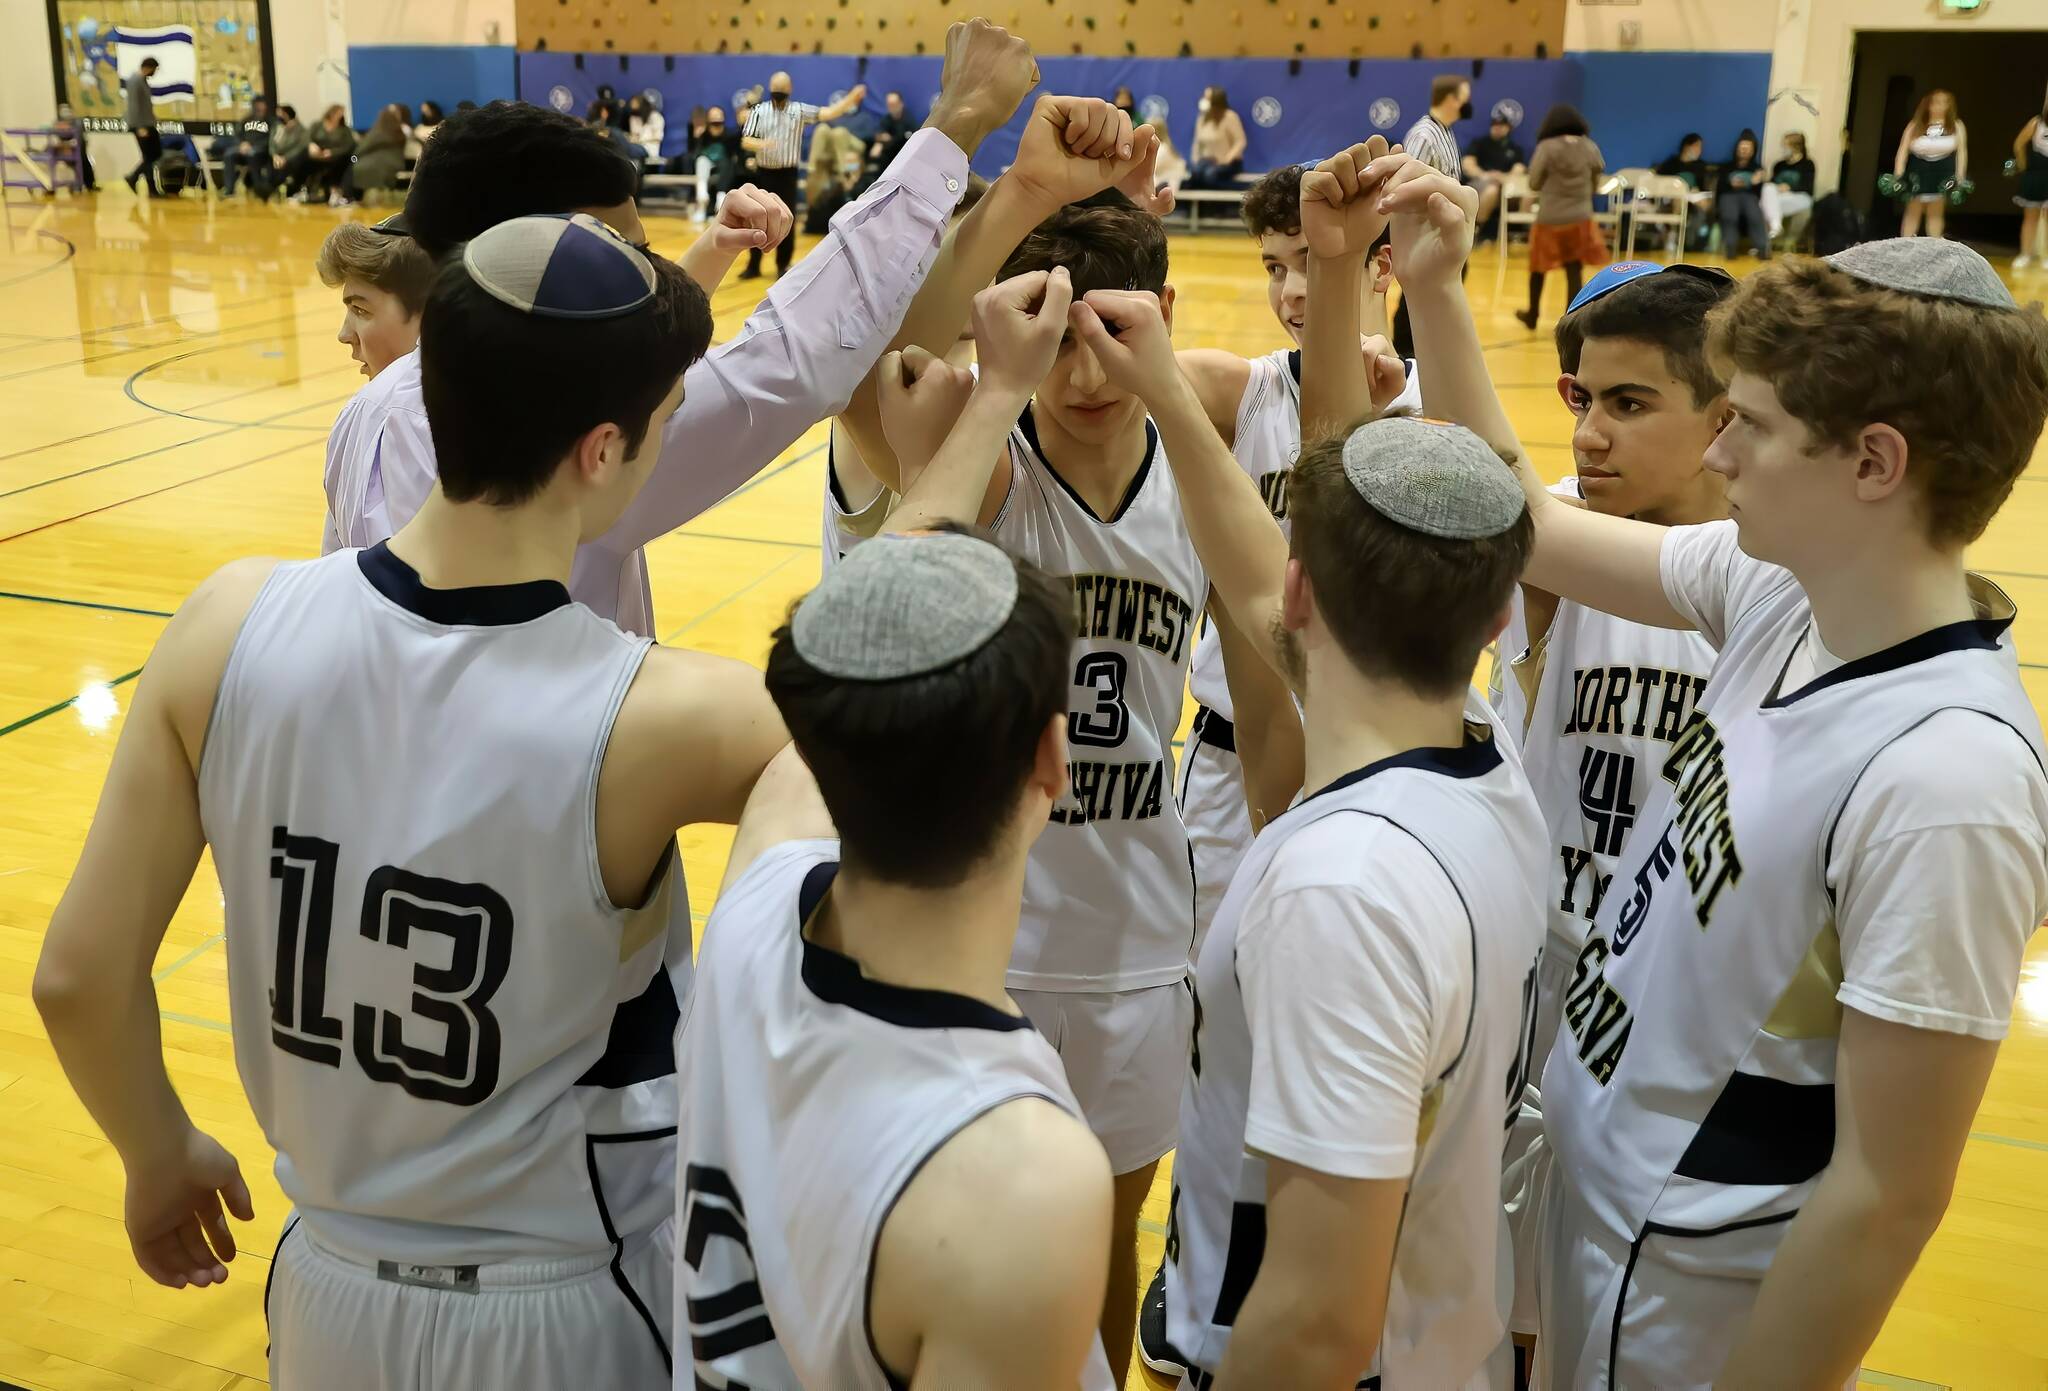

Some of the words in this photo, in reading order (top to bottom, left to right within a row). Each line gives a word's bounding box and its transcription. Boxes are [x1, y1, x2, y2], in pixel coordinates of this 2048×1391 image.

[1074, 575, 1193, 664] THWEST
[1067, 651, 1130, 749] 3
[1579, 745, 1637, 857] 4
[269, 826, 514, 1107] 13
